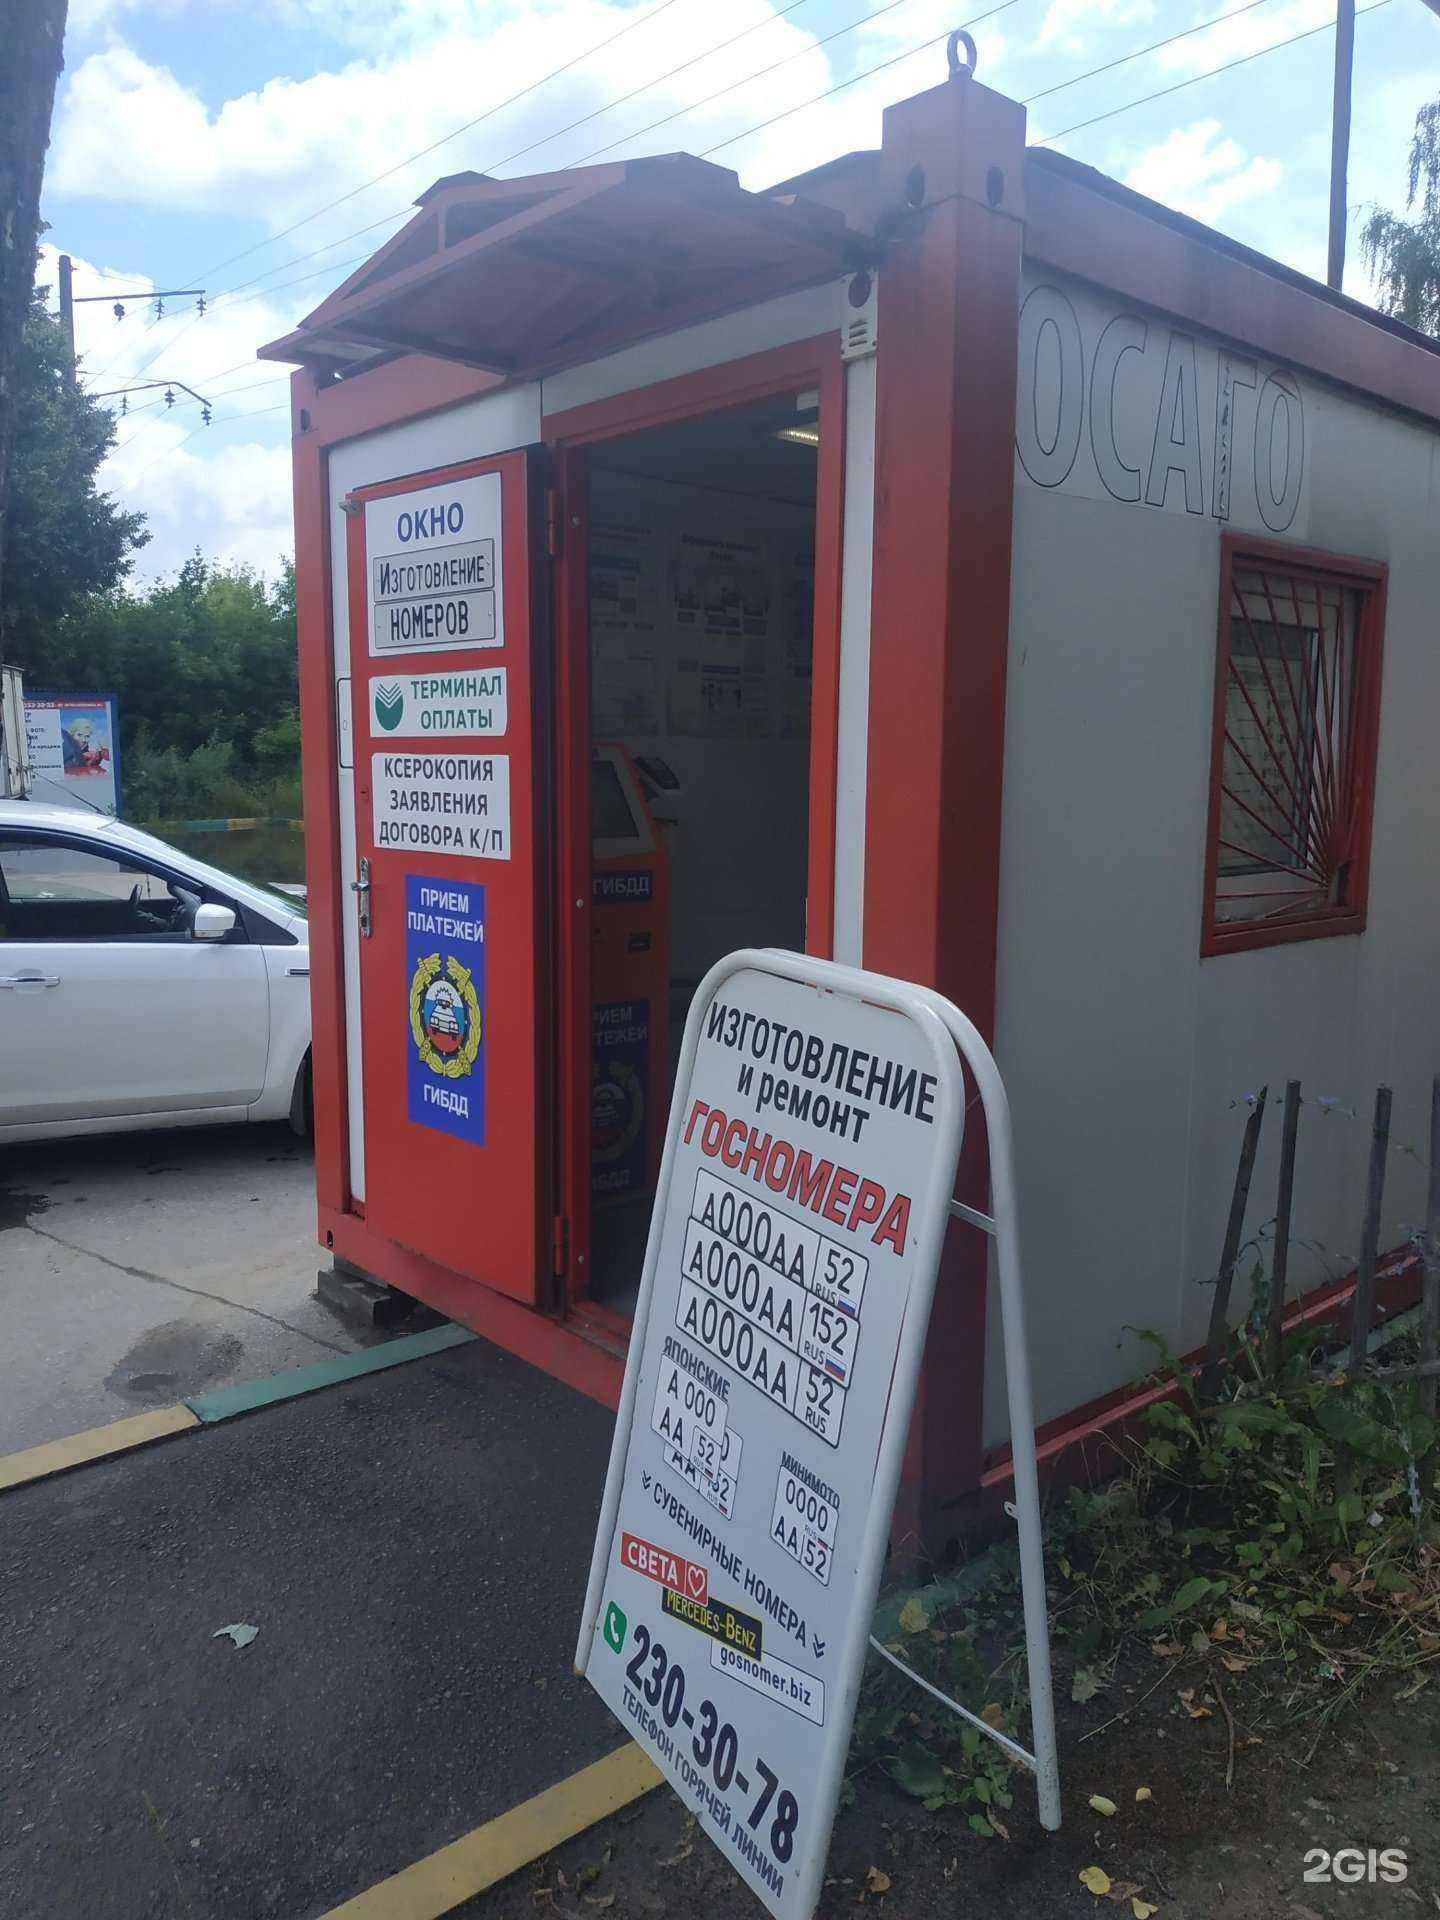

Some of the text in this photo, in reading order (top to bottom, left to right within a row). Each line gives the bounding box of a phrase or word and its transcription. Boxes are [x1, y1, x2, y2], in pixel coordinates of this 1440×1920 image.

[1015, 285, 1304, 532] ОСАГО
[397, 502, 464, 542] ОКНО
[380, 555, 485, 595] ИЗГОТОВЛЕНИЕ
[390, 600, 469, 641] НОМЕРОВ
[411, 675, 502, 700] ТЕРМИНАЛ
[420, 709, 493, 730] ОПЛАТЫ
[384, 758, 494, 781] КСЕРОКОПИЯ
[390, 789, 488, 816] ЗАЯВЛЕНИЯ
[379, 821, 503, 854] ДОГОВОРА К/П
[420, 887, 469, 914] ПРИЕМ
[408, 911, 484, 943] ПЛАТЕЖЕЙ
[707, 1001, 938, 1124] ИЗГОТОВЛЕНИЕ
[423, 1083, 469, 1119] ГИБДД
[737, 1063, 870, 1144] и ремонт
[683, 1099, 912, 1257] ГОСНОМЕРА
[824, 1250, 855, 1294] 52
[809, 1302, 848, 1356] 152
[664, 1336, 731, 1399] ЯПОНСКИЕ
[804, 1341, 824, 1365] RUS
[806, 1366, 834, 1416] 52
[805, 1406, 826, 1434] RUS
[698, 1435, 714, 1466] 52
[782, 1451, 840, 1509] МИНИМОТО
[628, 1541, 678, 1586] СВЕТА
[653, 1483, 807, 1648] СУВЕНИРНЫЕ НОМЕРА
[804, 1539, 826, 1578] 52
[720, 1645, 812, 1707] gosnomer.biz
[625, 1624, 799, 1865] 230-30-78
[622, 1685, 783, 1898] ТЕЛЕФОН ГОРЯЧЕЙ ЛИНИИ
